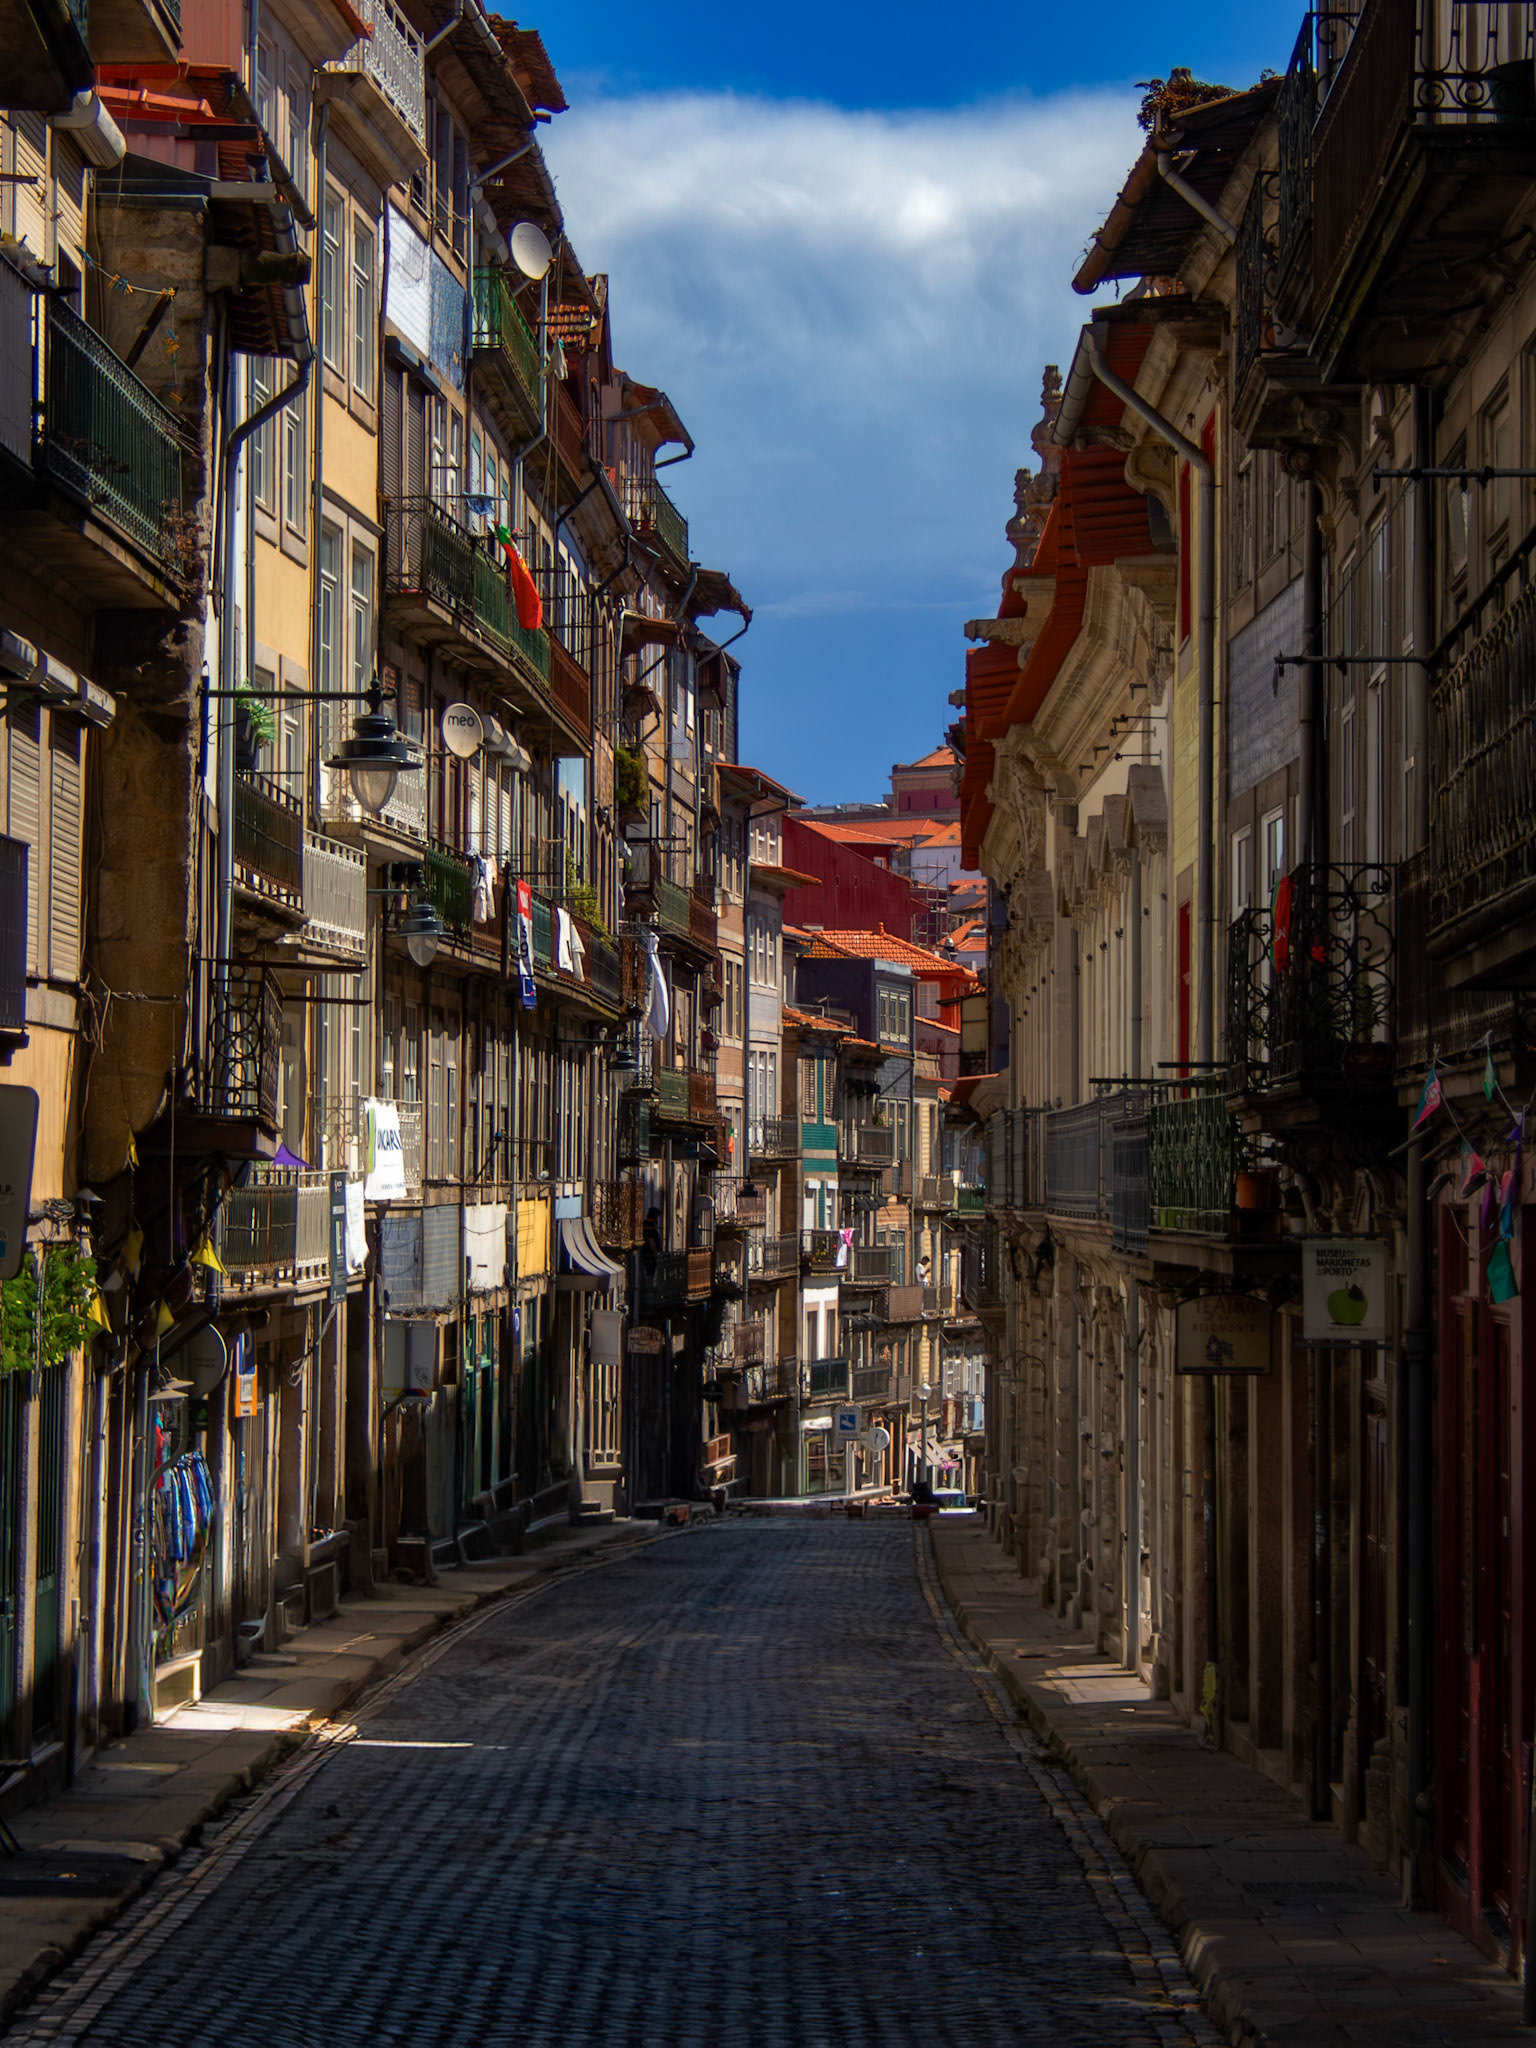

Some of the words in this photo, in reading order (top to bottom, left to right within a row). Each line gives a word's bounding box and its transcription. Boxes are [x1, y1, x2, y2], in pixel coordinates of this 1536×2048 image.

[447, 715, 475, 727] meo
[1316, 1249, 1345, 1257] MUSEU
[1316, 1258, 1371, 1267] MARIONETAS
[1324, 1267, 1352, 1276] PORTO
[1192, 1296, 1256, 1318] TEATRO
